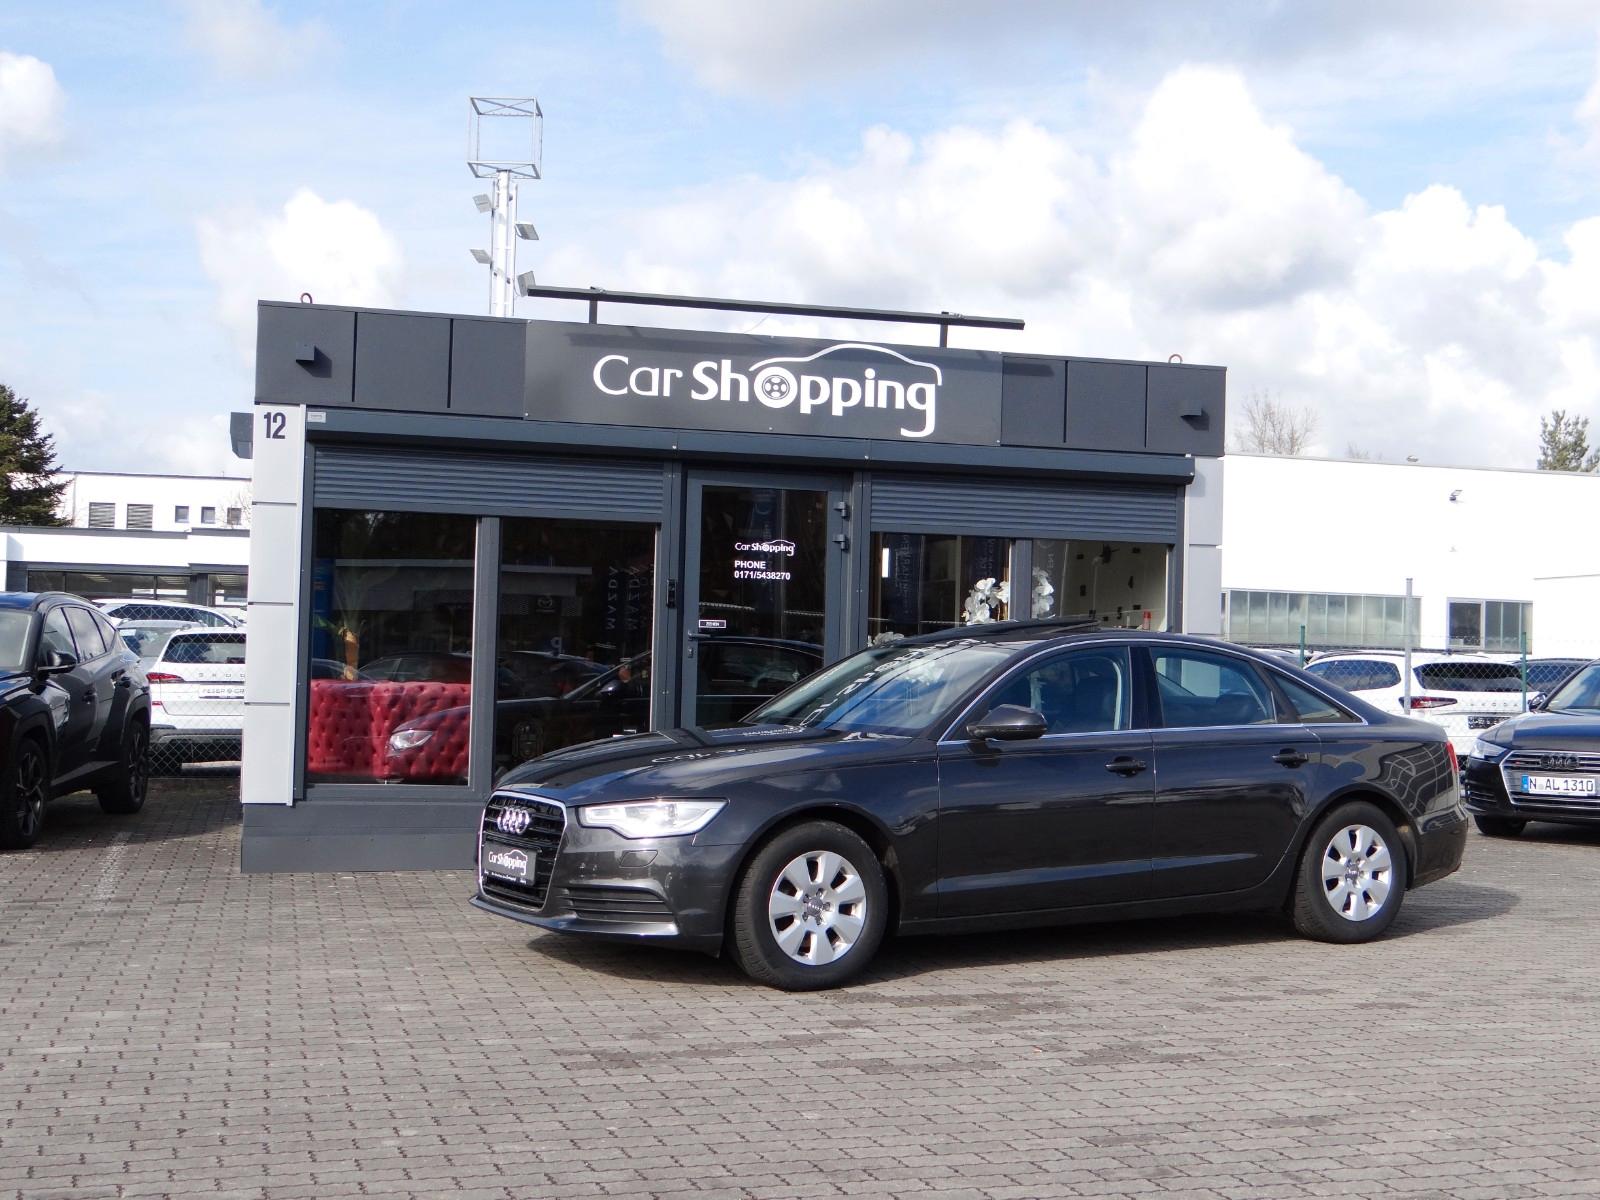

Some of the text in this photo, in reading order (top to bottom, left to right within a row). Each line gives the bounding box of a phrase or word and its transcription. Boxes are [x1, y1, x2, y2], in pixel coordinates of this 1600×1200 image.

[592, 354, 937, 439] Car Shopping
[263, 411, 286, 440] 12
[734, 542, 794, 557] Car Shopping
[734, 560, 766, 569] PHONE
[734, 570, 791, 581] 0171/5438270
[1529, 778, 1594, 792] N AL 1310
[489, 852, 497, 862] Car
[497, 853, 526, 875] Shopping
